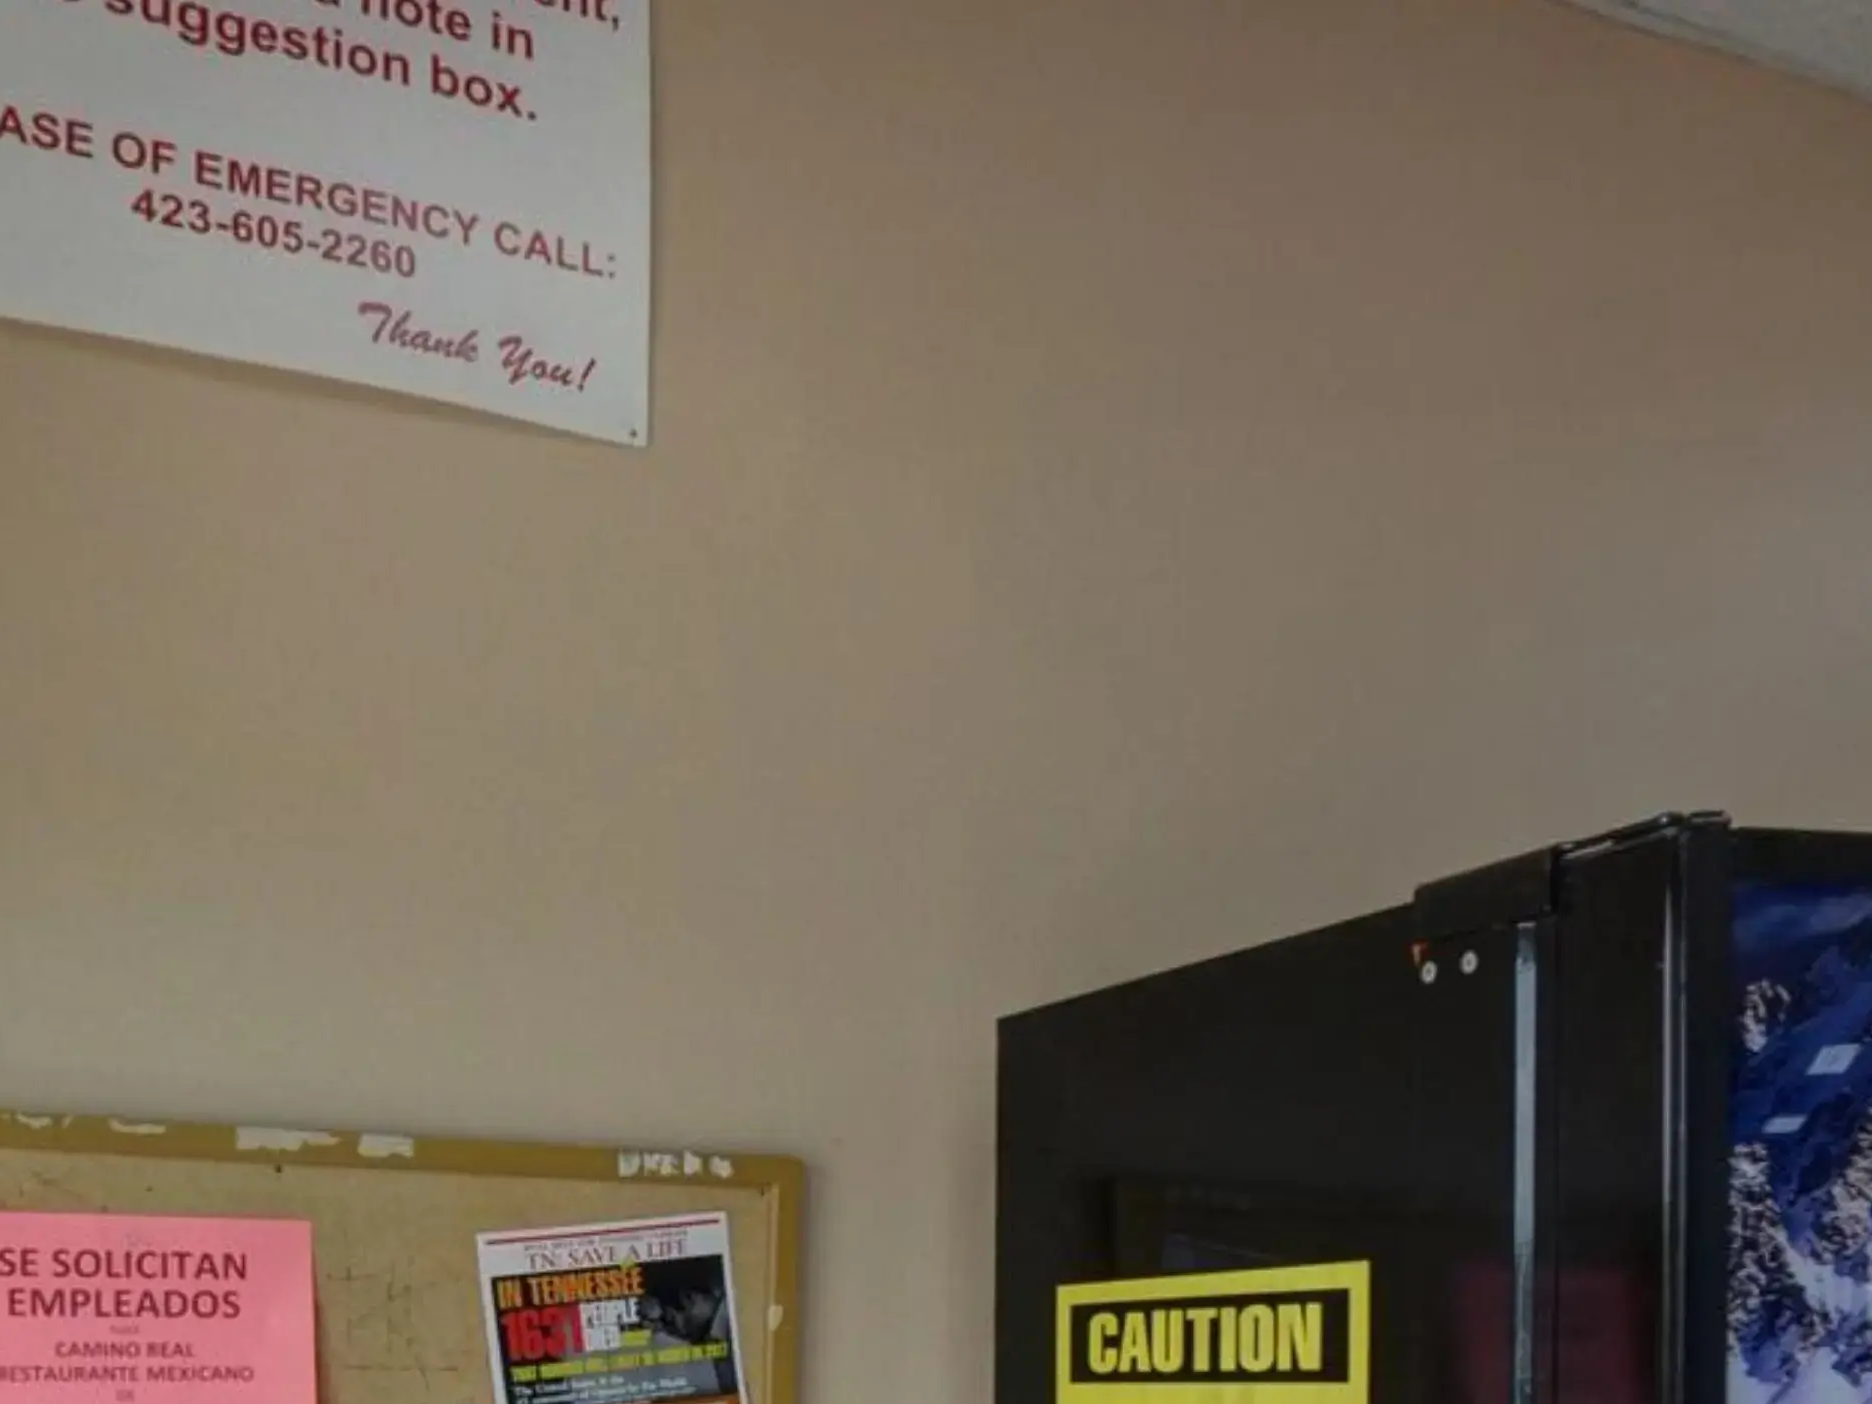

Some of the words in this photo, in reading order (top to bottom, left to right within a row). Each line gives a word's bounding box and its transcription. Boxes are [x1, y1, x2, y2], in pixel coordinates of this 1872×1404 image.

[491, 11, 534, 59] in
[430, 53, 538, 121] box.
[112, 131, 178, 174] OF
[193, 150, 479, 246] EMERGENCY
[494, 221, 616, 279] CALL:
[131, 188, 416, 278] 423-605-2260
[358, 300, 479, 362] Thank
[498, 335, 597, 392] You!
[52, 1248, 247, 1280] SOLICITAN
[528, 1267, 645, 1306] TENNESSEE
[7, 1288, 241, 1319] EMPLEADOS
[55, 1341, 141, 1358] CAMINO
[146, 1341, 195, 1358] REAL
[1087, 1302, 1323, 1374] CAUTION
[146, 1365, 254, 1382] MEXICANO
